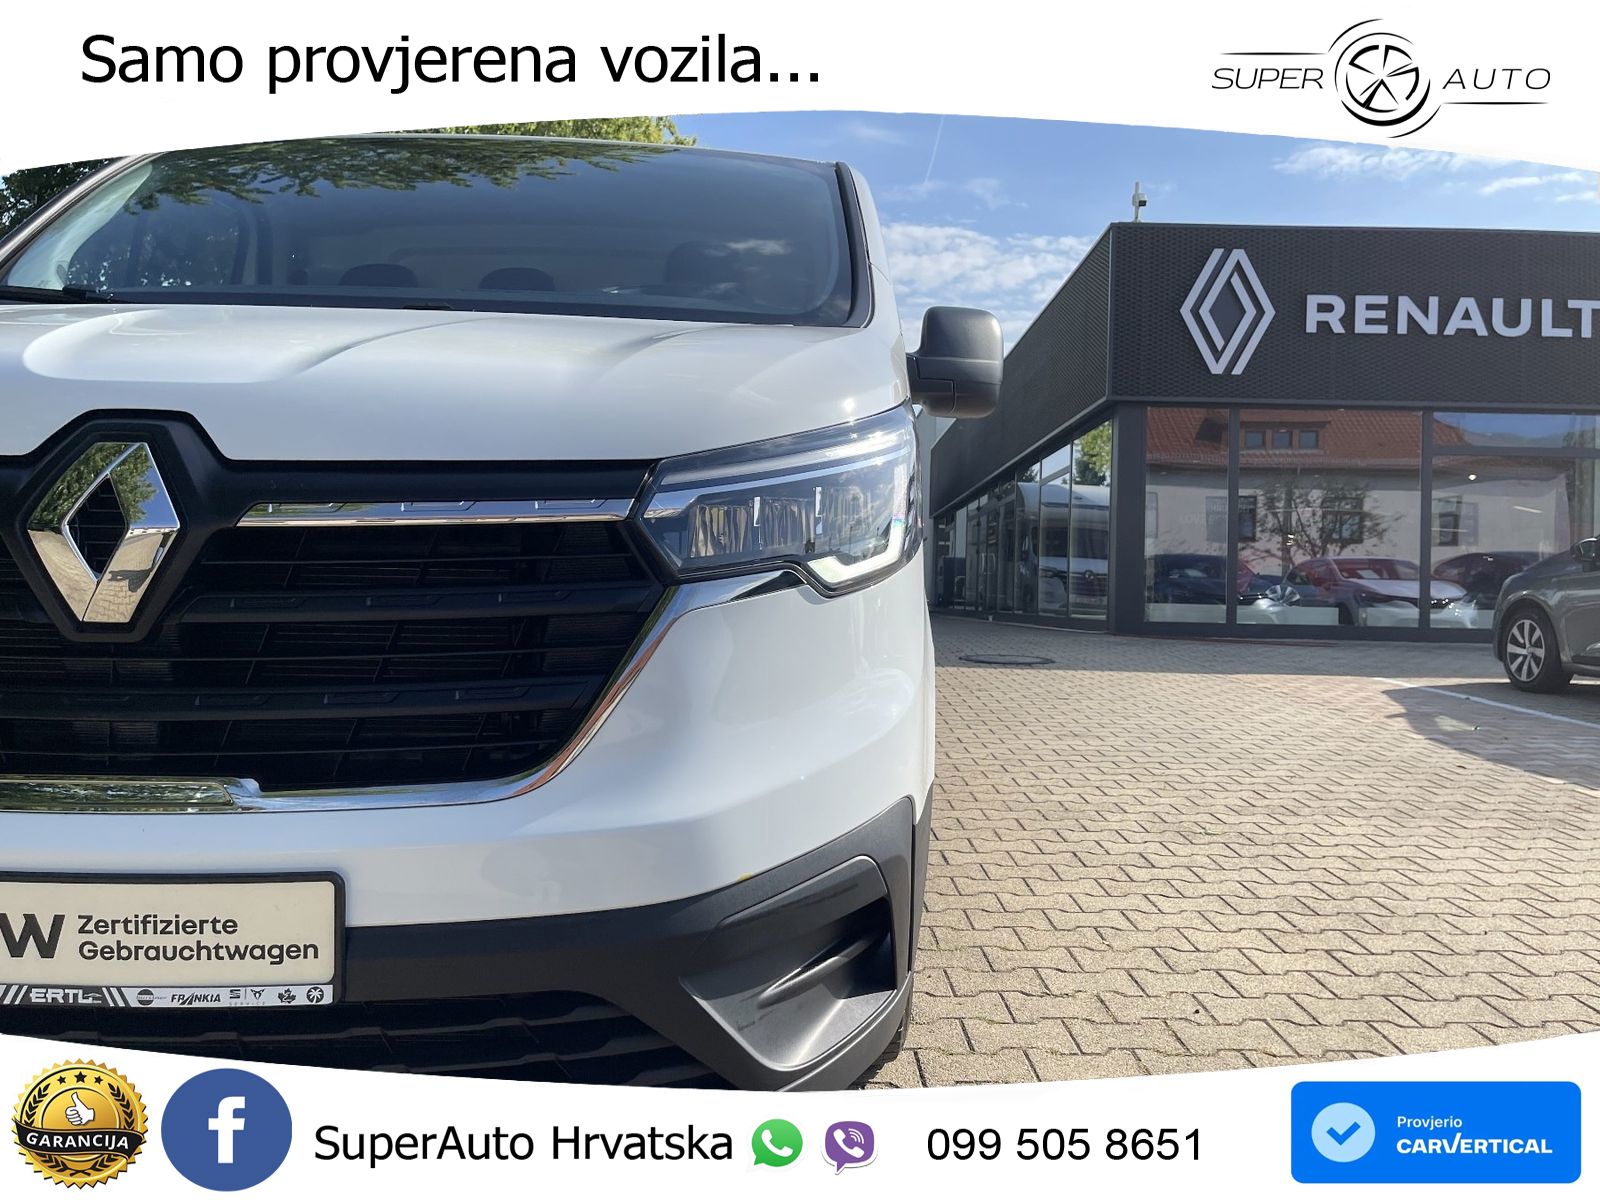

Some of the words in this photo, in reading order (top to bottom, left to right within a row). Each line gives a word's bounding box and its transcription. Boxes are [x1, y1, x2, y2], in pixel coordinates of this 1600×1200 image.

[1306, 294, 1600, 338] RENAULT
[77, 914, 238, 935] Zertifizierte
[78, 939, 319, 965] Gebrauchtwagen
[30, 988, 95, 1004] ERTL
